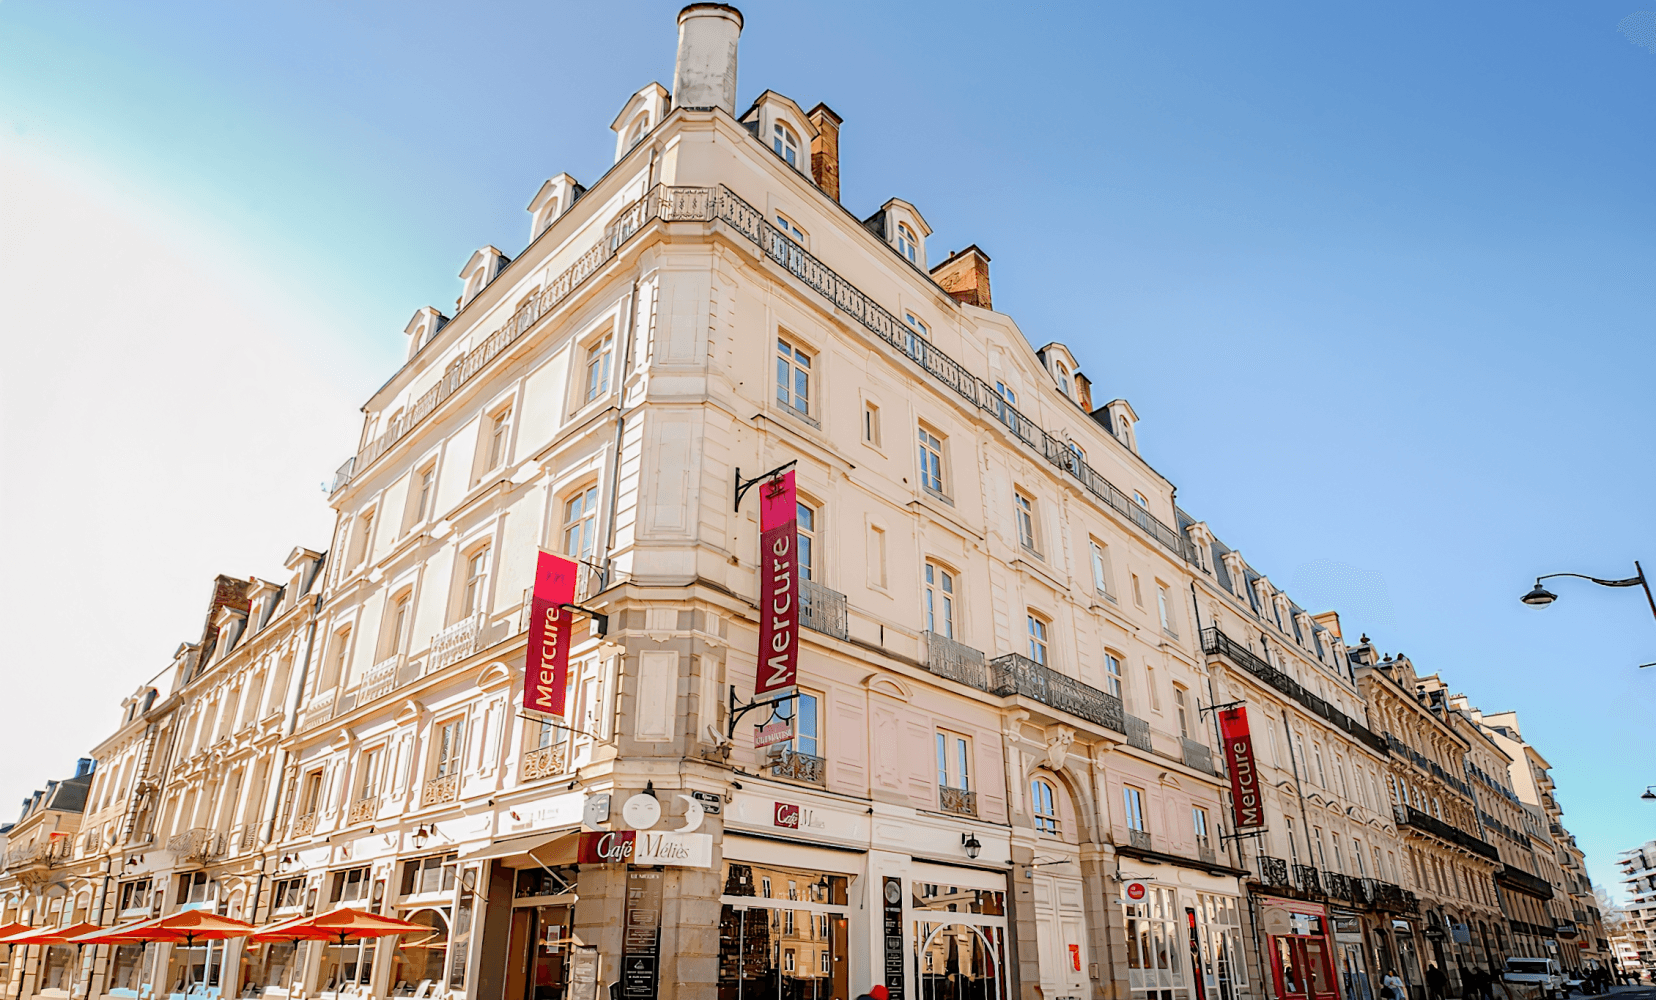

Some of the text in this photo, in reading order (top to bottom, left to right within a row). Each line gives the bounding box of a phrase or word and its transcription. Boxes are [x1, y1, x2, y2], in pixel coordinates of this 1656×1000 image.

[765, 535, 795, 687] Mercure
[535, 607, 560, 707] Mercure
[777, 804, 798, 828] Café
[1233, 742, 1258, 825] Mercure
[596, 832, 690, 863] Café Méliès
